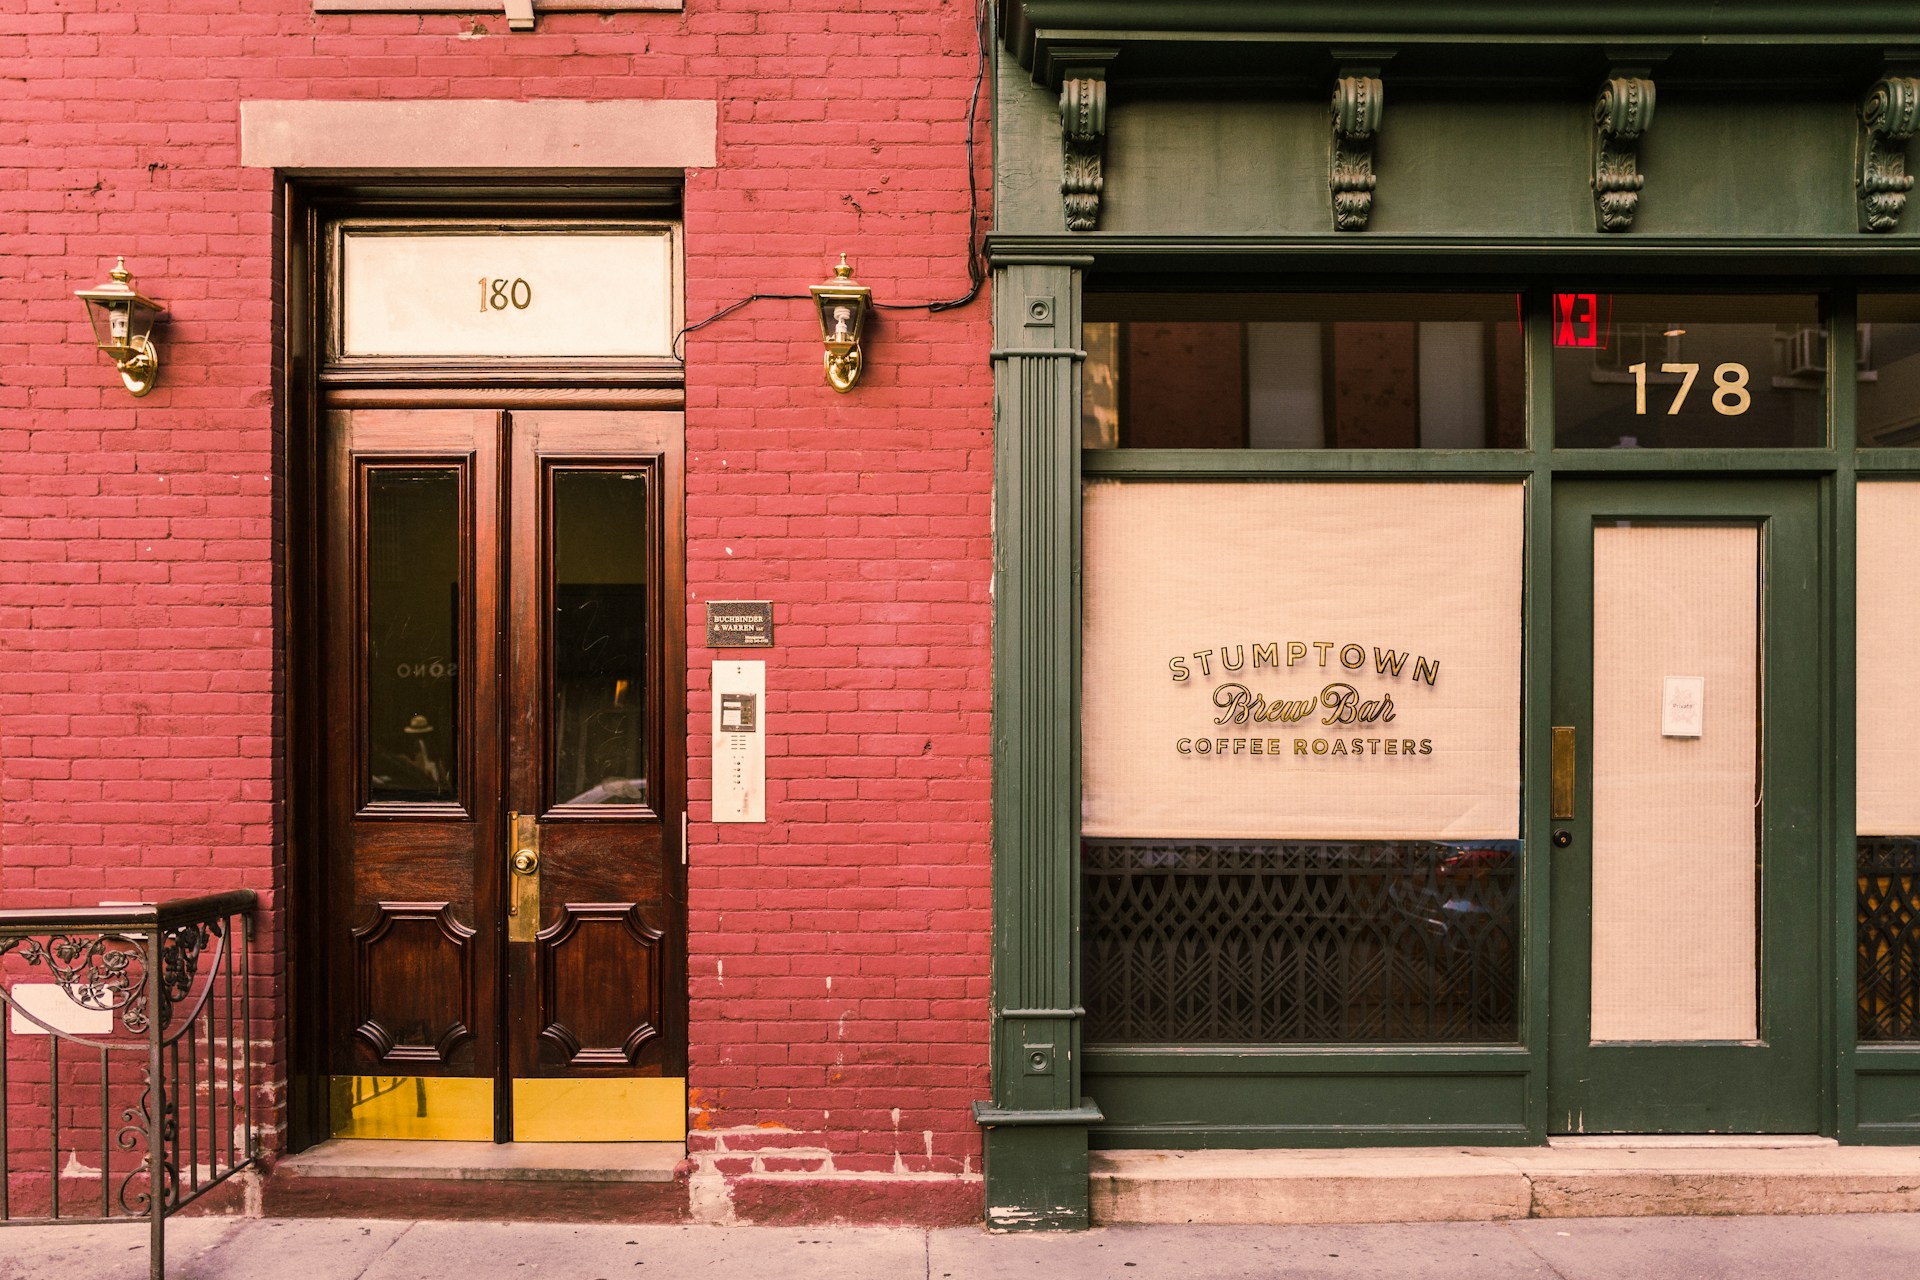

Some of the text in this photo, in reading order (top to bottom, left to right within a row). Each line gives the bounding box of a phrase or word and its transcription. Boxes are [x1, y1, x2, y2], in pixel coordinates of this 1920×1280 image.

[478, 277, 532, 313] 180
[1628, 361, 1751, 416] 178
[1168, 641, 1441, 686] STUMPTOWN
[1212, 682, 1397, 726] Brew Bar
[1176, 737, 1433, 756] COFFEE ROASTERS
